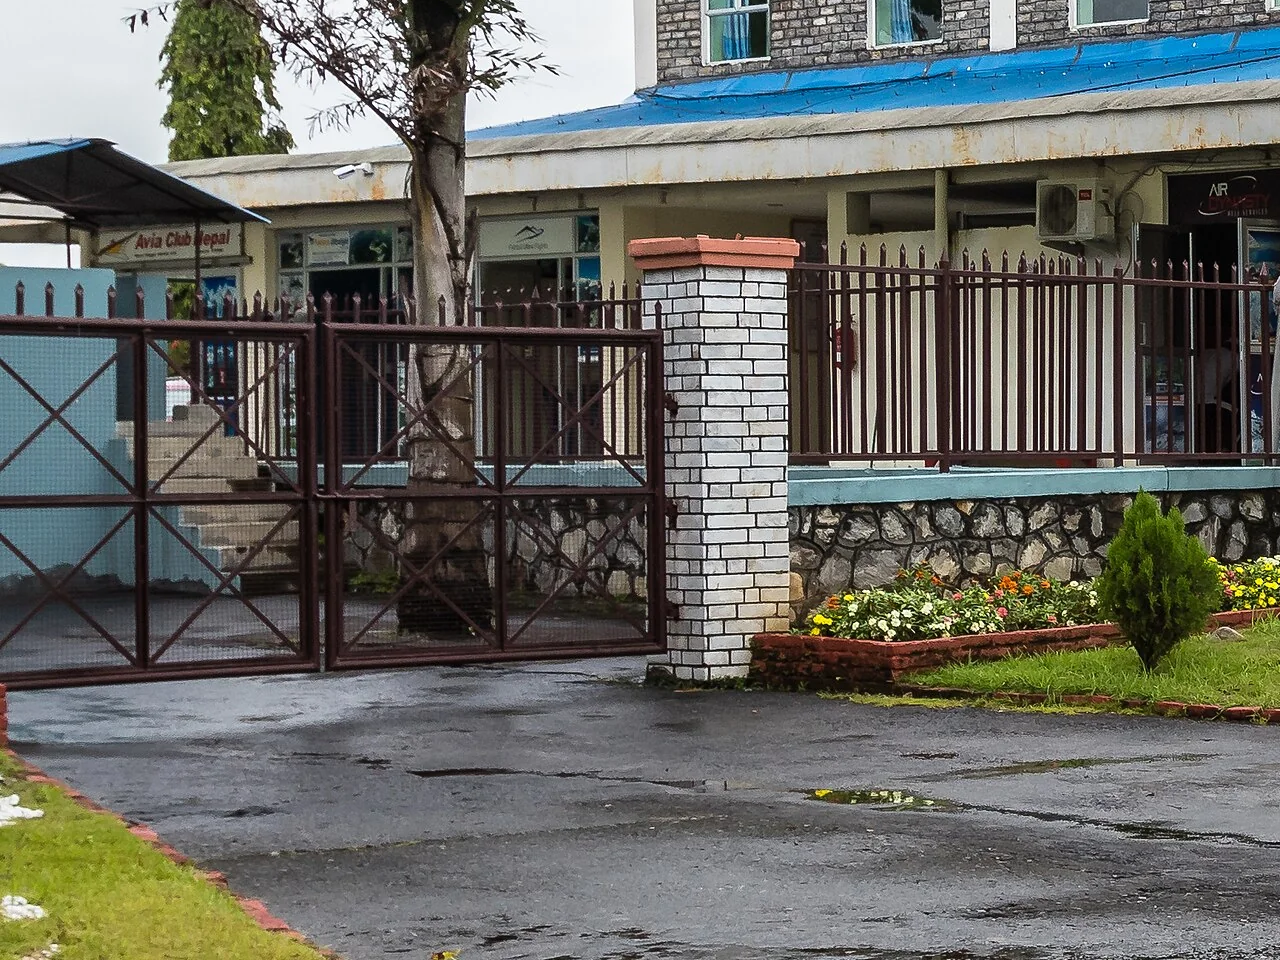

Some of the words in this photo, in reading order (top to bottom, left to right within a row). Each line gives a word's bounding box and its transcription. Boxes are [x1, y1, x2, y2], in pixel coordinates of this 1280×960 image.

[1209, 182, 1228, 197] AIR
[135, 234, 162, 249] Avia
[165, 231, 192, 248] Club
